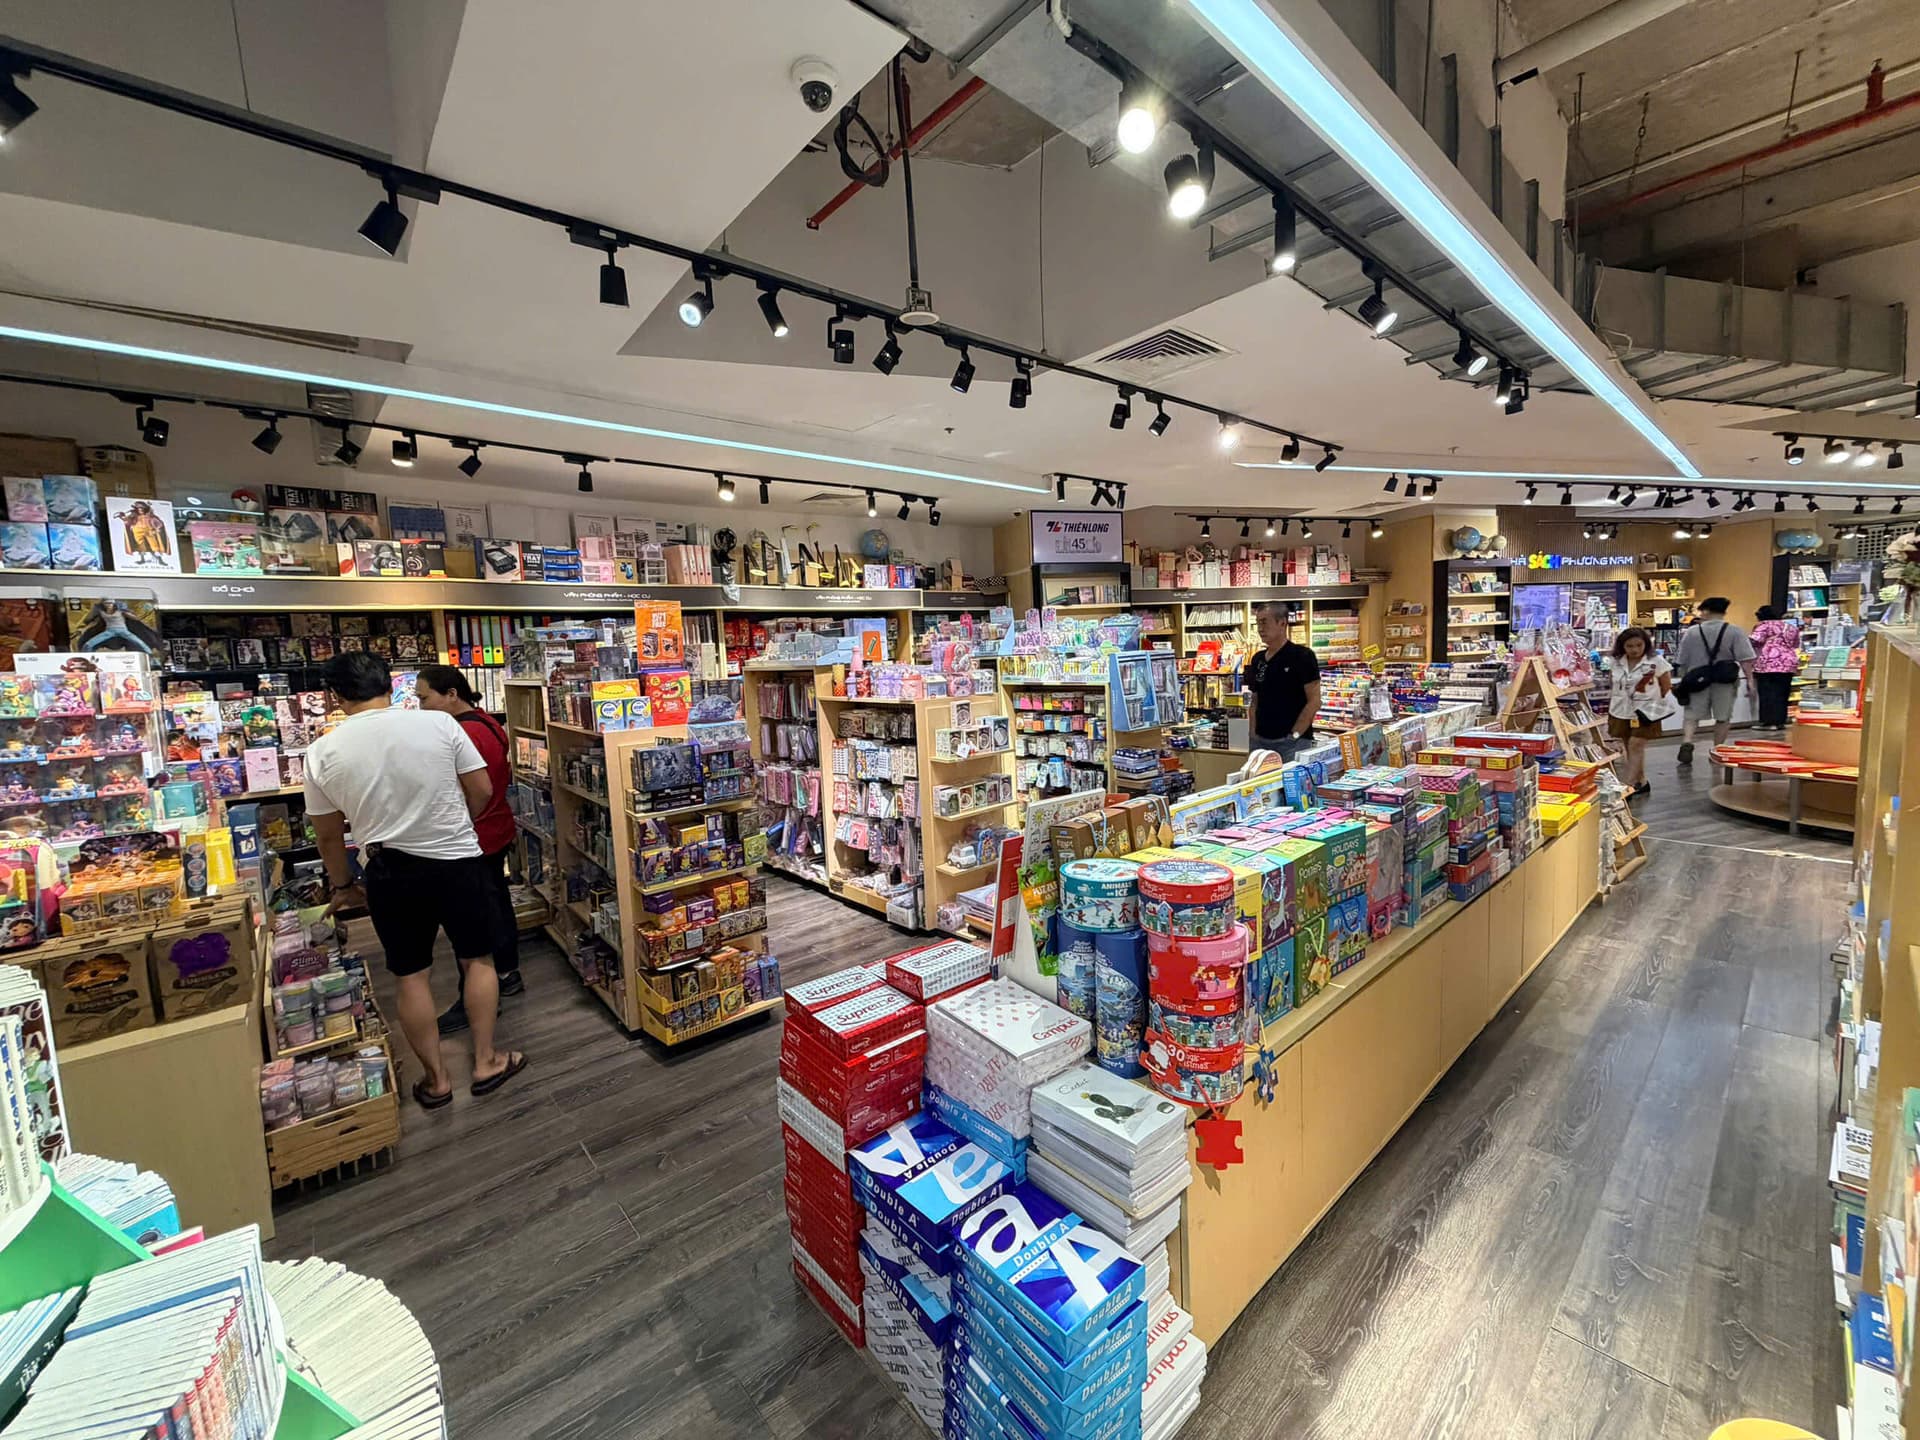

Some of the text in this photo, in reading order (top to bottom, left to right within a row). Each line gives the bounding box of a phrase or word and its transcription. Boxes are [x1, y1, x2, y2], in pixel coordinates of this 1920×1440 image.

[1071, 538, 1086, 550] 45
[1510, 554, 1527, 566] HÀ
[1528, 550, 1562, 570] SÁCH
[1609, 556, 1633, 565] NAM
[1101, 881, 1133, 890] ANIMALS
[1114, 888, 1129, 897] ICE
[805, 972, 866, 999] Supreme
[836, 992, 901, 1026] Supreme
[1032, 1018, 1080, 1041] Campus
[1167, 1044, 1185, 1062] 30
[929, 1090, 958, 1116] Double
[961, 1111, 970, 1123] A
[904, 1142, 958, 1183] Double A
[865, 1174, 919, 1228] Double A
[951, 1186, 998, 1228] Double A
[868, 1201, 922, 1255] Double A
[1012, 1231, 1058, 1268] Double
[1060, 1222, 1070, 1234] A
[872, 1254, 921, 1321] Double A
[953, 1243, 994, 1285] Double
[996, 1284, 1006, 1297] A
[956, 1273, 1006, 1329] Double A
[1084, 1281, 1133, 1334] Double A
[956, 1301, 1005, 1360] Double A
[1082, 1318, 1134, 1370] Double A
[1147, 1310, 1180, 1350] ampus
[956, 1324, 1006, 1386] Double A
[1081, 1349, 1133, 1402] Double A
[952, 1353, 1000, 1416] Double A
[1083, 1373, 1134, 1428] Double A
[951, 1407, 979, 1440] Doub
